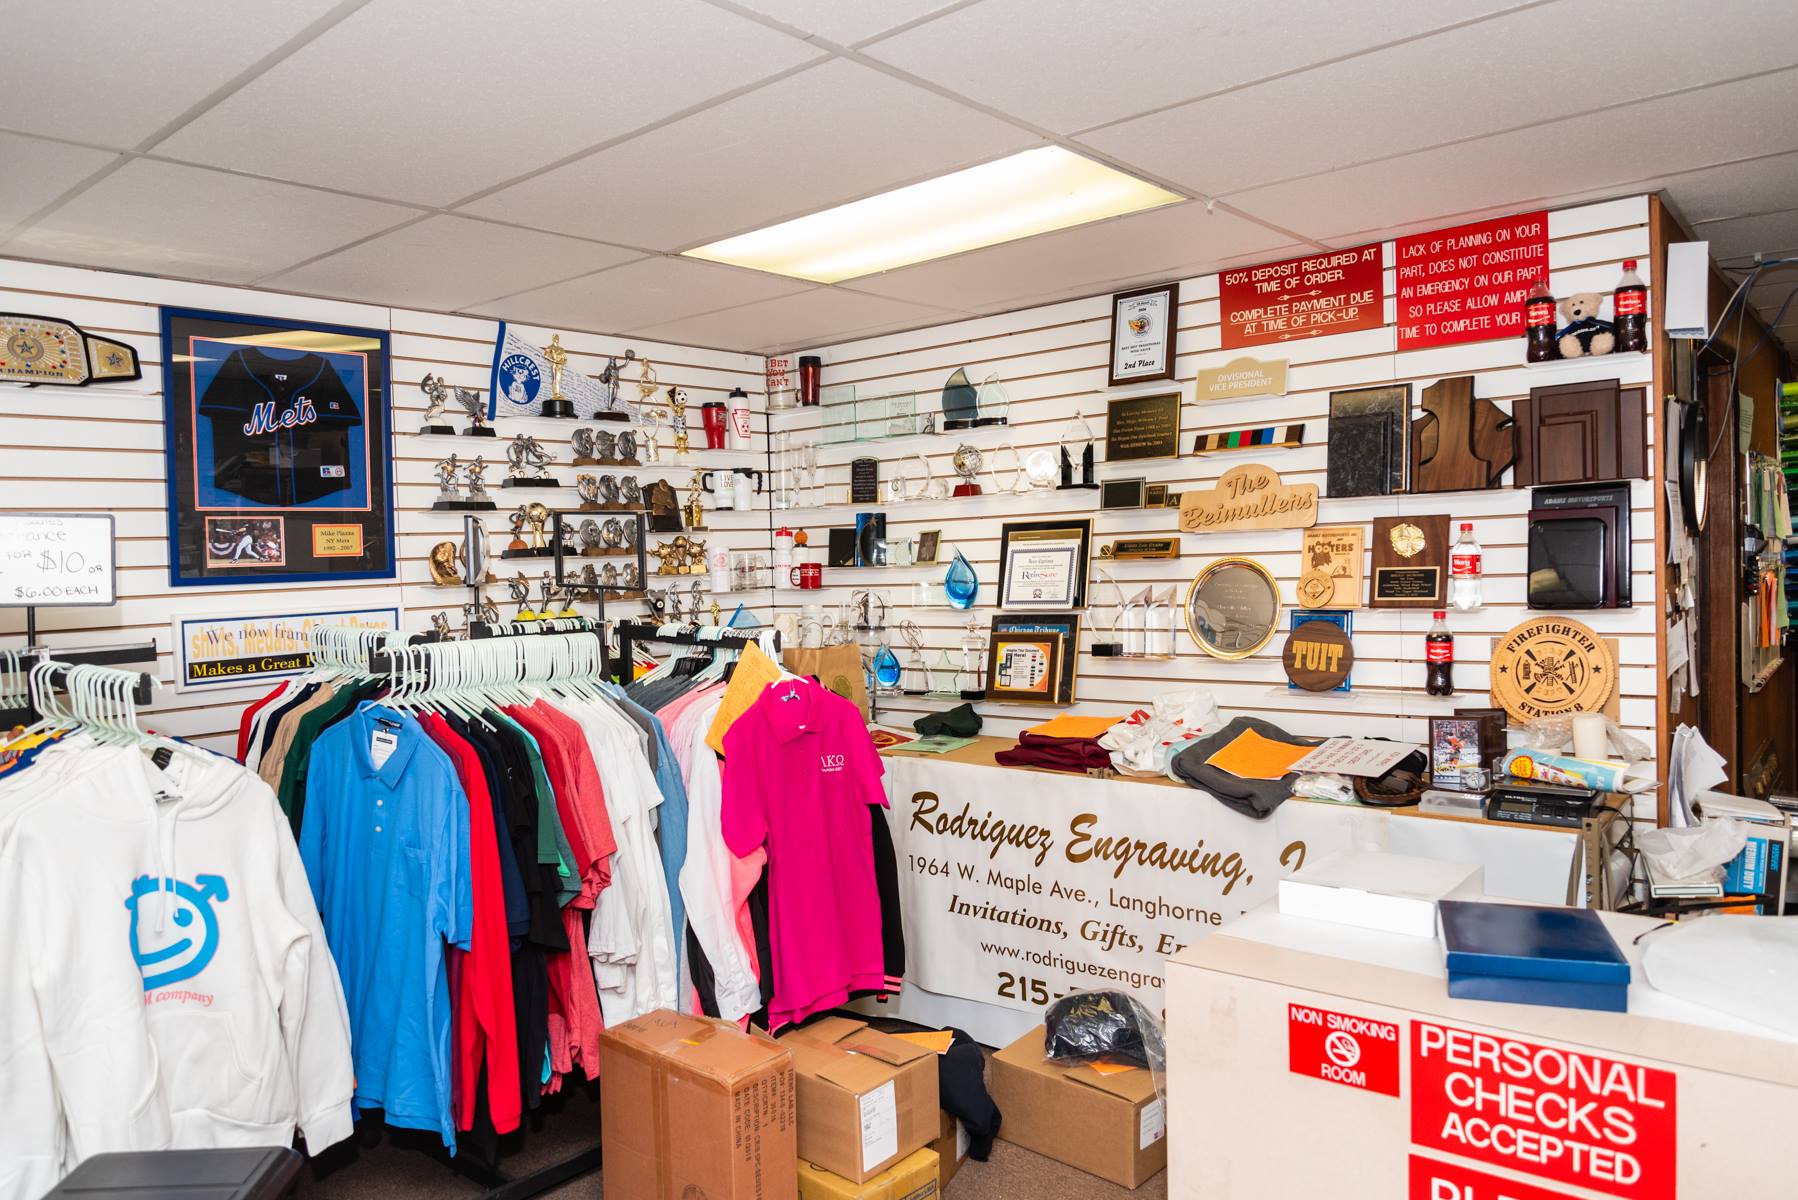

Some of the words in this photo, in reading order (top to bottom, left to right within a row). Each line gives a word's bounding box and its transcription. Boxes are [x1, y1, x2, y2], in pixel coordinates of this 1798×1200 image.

[1403, 244, 1426, 258] LACK
[1430, 240, 1443, 254] OF
[1447, 231, 1492, 250] PLANNING
[1496, 228, 1510, 242] ON
[1515, 223, 1541, 238] YOUR
[1225, 272, 1248, 285] 50%
[1252, 263, 1298, 281] DEPOSIT
[1302, 252, 1358, 272] REQUIRED
[1362, 248, 1377, 262] AT
[1400, 263, 1425, 279] PART,
[1429, 259, 1455, 275] DOES
[1459, 255, 1478, 269] NOT
[1483, 244, 1544, 264] CONSTITUTE
[1255, 281, 1281, 294] TIME
[1285, 276, 1300, 289] OF
[1304, 269, 1345, 286] ORDER.
[1401, 286, 1413, 299] AN
[1417, 277, 1470, 297] EMERGENCY
[1474, 275, 1488, 289] ON
[1492, 270, 1513, 285] OUR
[1517, 265, 1543, 281] PART
[1230, 304, 1289, 323] COMPLETE
[1292, 295, 1346, 315] PAYMENT
[1350, 290, 1373, 304] DUE
[1409, 305, 1423, 318] SO
[1427, 299, 1461, 316] PLEASE
[1466, 294, 1499, 310] ALLOW
[1244, 322, 1257, 334] AT
[1262, 318, 1287, 331] TIME
[1291, 315, 1306, 327] OF
[1311, 307, 1359, 324] PICK-UP.
[1400, 326, 1420, 339] TIME
[1425, 323, 1437, 336] TO
[1441, 316, 1491, 334] COMPLETE
[1495, 312, 1520, 326] YOUR
[0, 368, 64, 377] HAMPION
[502, 356, 539, 381] HILLCREST
[770, 359, 788, 367] BET
[1124, 362, 1136, 370] 2nd
[1138, 359, 1155, 367] Place
[1217, 370, 1264, 383] DIVISIONAL
[1209, 382, 1226, 393] VICE
[1229, 377, 1272, 390] PRESIDENT
[243, 396, 317, 436] Mets
[1226, 473, 1269, 500] The
[1169, 496, 1178, 505] A
[36, 549, 84, 574] $10
[1308, 543, 1354, 554] HOOTERS
[14, 586, 62, 600] $6.00
[65, 586, 98, 595] EACH
[206, 629, 233, 646] We
[239, 626, 269, 641] now
[275, 624, 309, 642] fram
[1506, 624, 1596, 653] FIREFIGHTER
[192, 660, 243, 678] Makes
[247, 663, 257, 673] a
[261, 657, 301, 671] Great
[1292, 640, 1344, 673] TUIT
[1574, 702, 1584, 712] 8
[910, 791, 1054, 867] Rodriguez
[1065, 813, 1254, 896] Engraving,
[908, 853, 950, 879] 1964
[957, 862, 980, 884] W.
[987, 869, 1042, 896] Maple
[1049, 882, 1099, 908] Ave.,
[1109, 887, 1222, 926] Langhorne
[948, 894, 1069, 940] Invitations,
[1080, 919, 1144, 954] Gifts,
[156, 990, 213, 1007] company
[998, 971, 1082, 1006] 215-
[1291, 1007, 1323, 1027] NON
[1327, 1013, 1396, 1041] SMOKING
[1321, 1065, 1366, 1087] ROOM
[1420, 1024, 1665, 1109] PERSONAL
[1444, 1072, 1637, 1145] CHECKS
[1440, 1112, 1641, 1185] ACCEPTED
